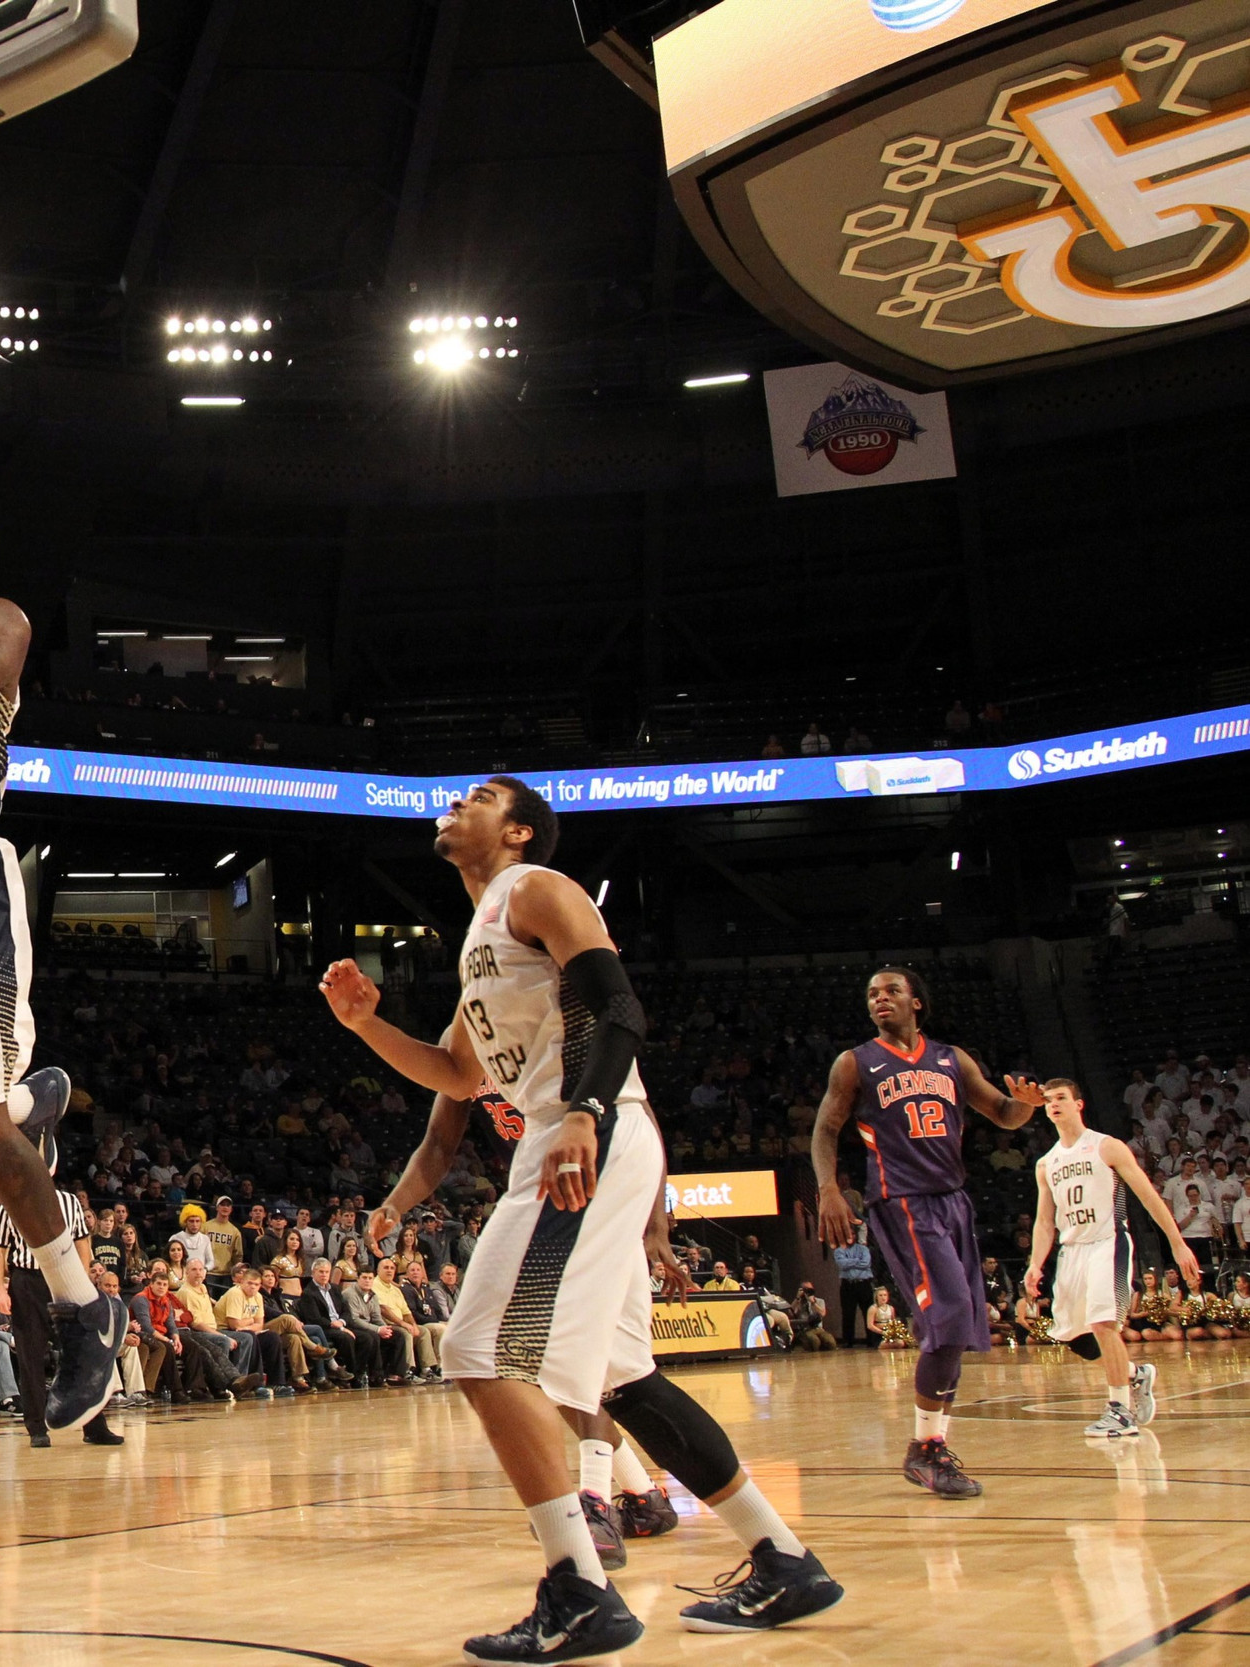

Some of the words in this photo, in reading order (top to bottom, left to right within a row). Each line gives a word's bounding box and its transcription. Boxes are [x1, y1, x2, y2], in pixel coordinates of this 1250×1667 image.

[810, 420, 840, 440] NCAA
[840, 414, 878, 429] FINAL
[880, 414, 909, 431] FOUR
[837, 431, 882, 450] 1990
[1043, 731, 1167, 774] Suddath
[557, 779, 584, 801] for
[589, 776, 669, 801] Moving
[673, 773, 707, 796] the
[896, 775, 931, 787] Suddath
[365, 782, 426, 813] Setting
[431, 785, 462, 808] the
[463, 999, 494, 1042] 13
[877, 1070, 956, 1109] CLEMSON
[483, 1101, 525, 1141] 35
[904, 1101, 947, 1138] 12
[1052, 1161, 1093, 1186] GEORGIA
[682, 1182, 733, 1207] at&t
[1067, 1185, 1083, 1206] 10
[1065, 1208, 1096, 1227] TECH
[209, 1231, 233, 1245] TECH
